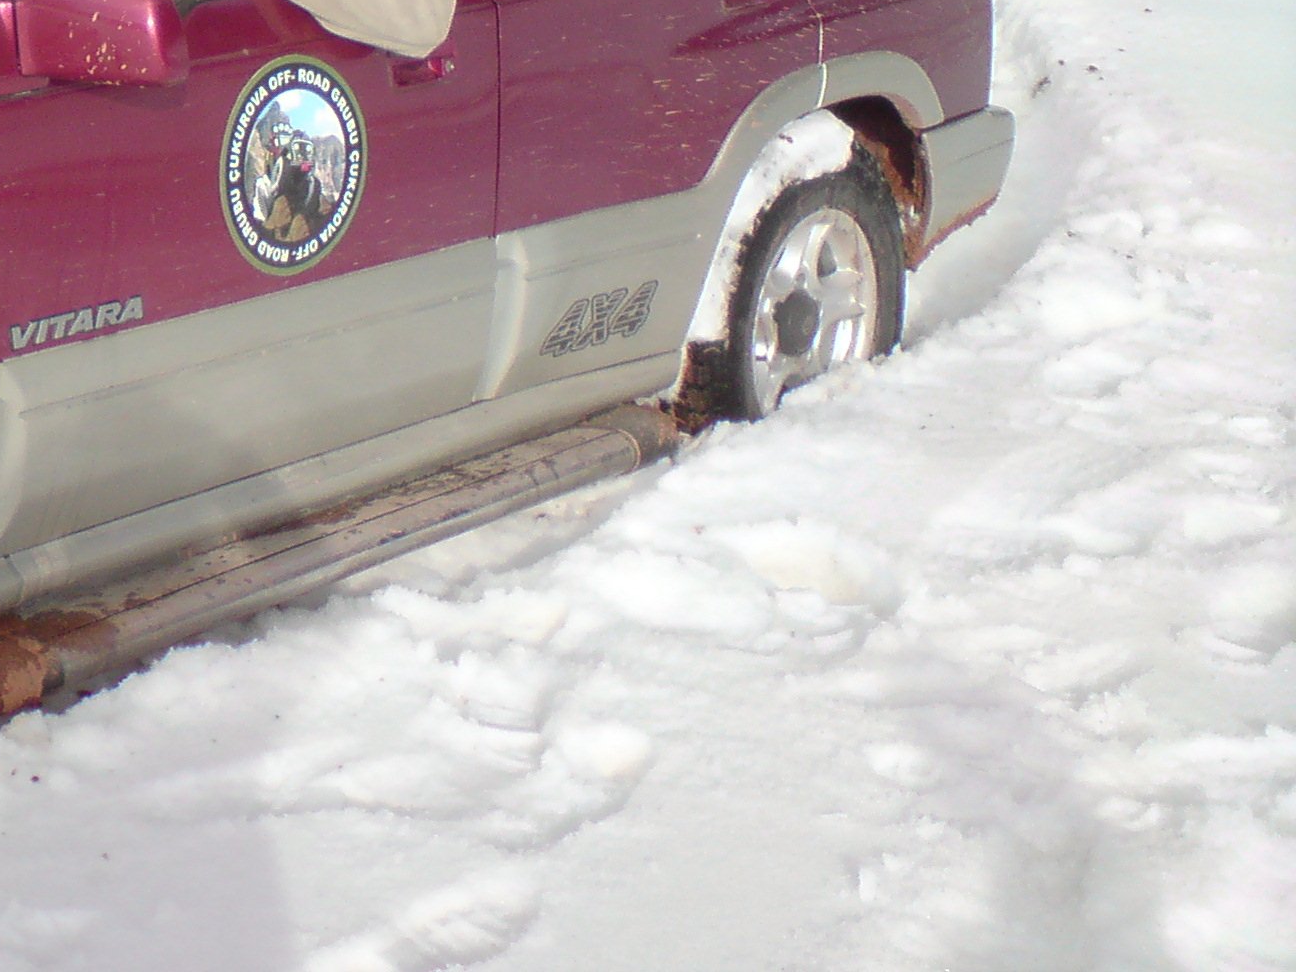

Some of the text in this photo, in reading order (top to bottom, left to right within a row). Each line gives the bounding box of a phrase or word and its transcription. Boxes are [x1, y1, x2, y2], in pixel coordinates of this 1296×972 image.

[331, 88, 360, 145] GRUBU
[230, 188, 258, 245] GRUBU
[10, 294, 143, 351] VITARA
